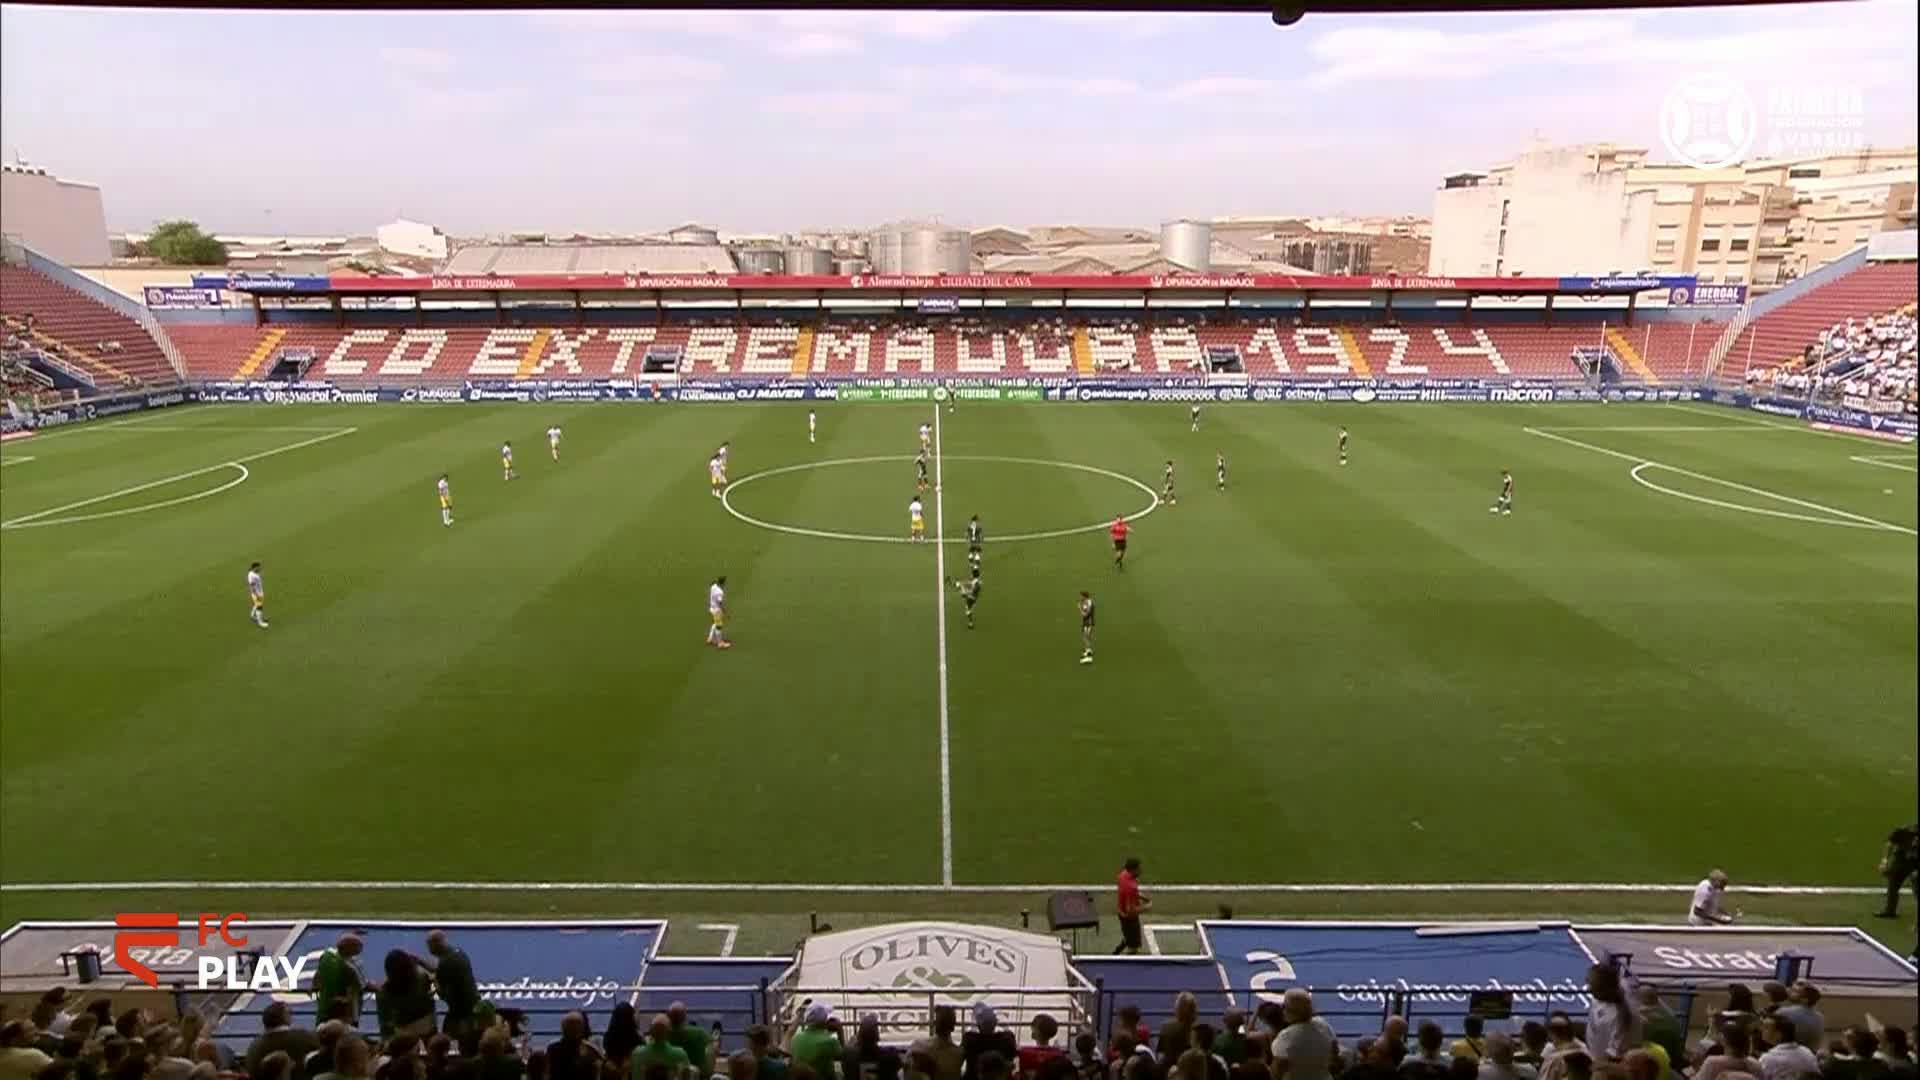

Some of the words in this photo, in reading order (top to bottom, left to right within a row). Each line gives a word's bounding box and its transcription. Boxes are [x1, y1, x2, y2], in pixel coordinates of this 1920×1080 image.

[324, 329, 448, 374] CD
[1246, 328, 1510, 373] 1924
[1491, 388, 1553, 401] macron
[851, 935, 1016, 975] OLIVES
[1336, 977, 1593, 1008] cajalmendralej
